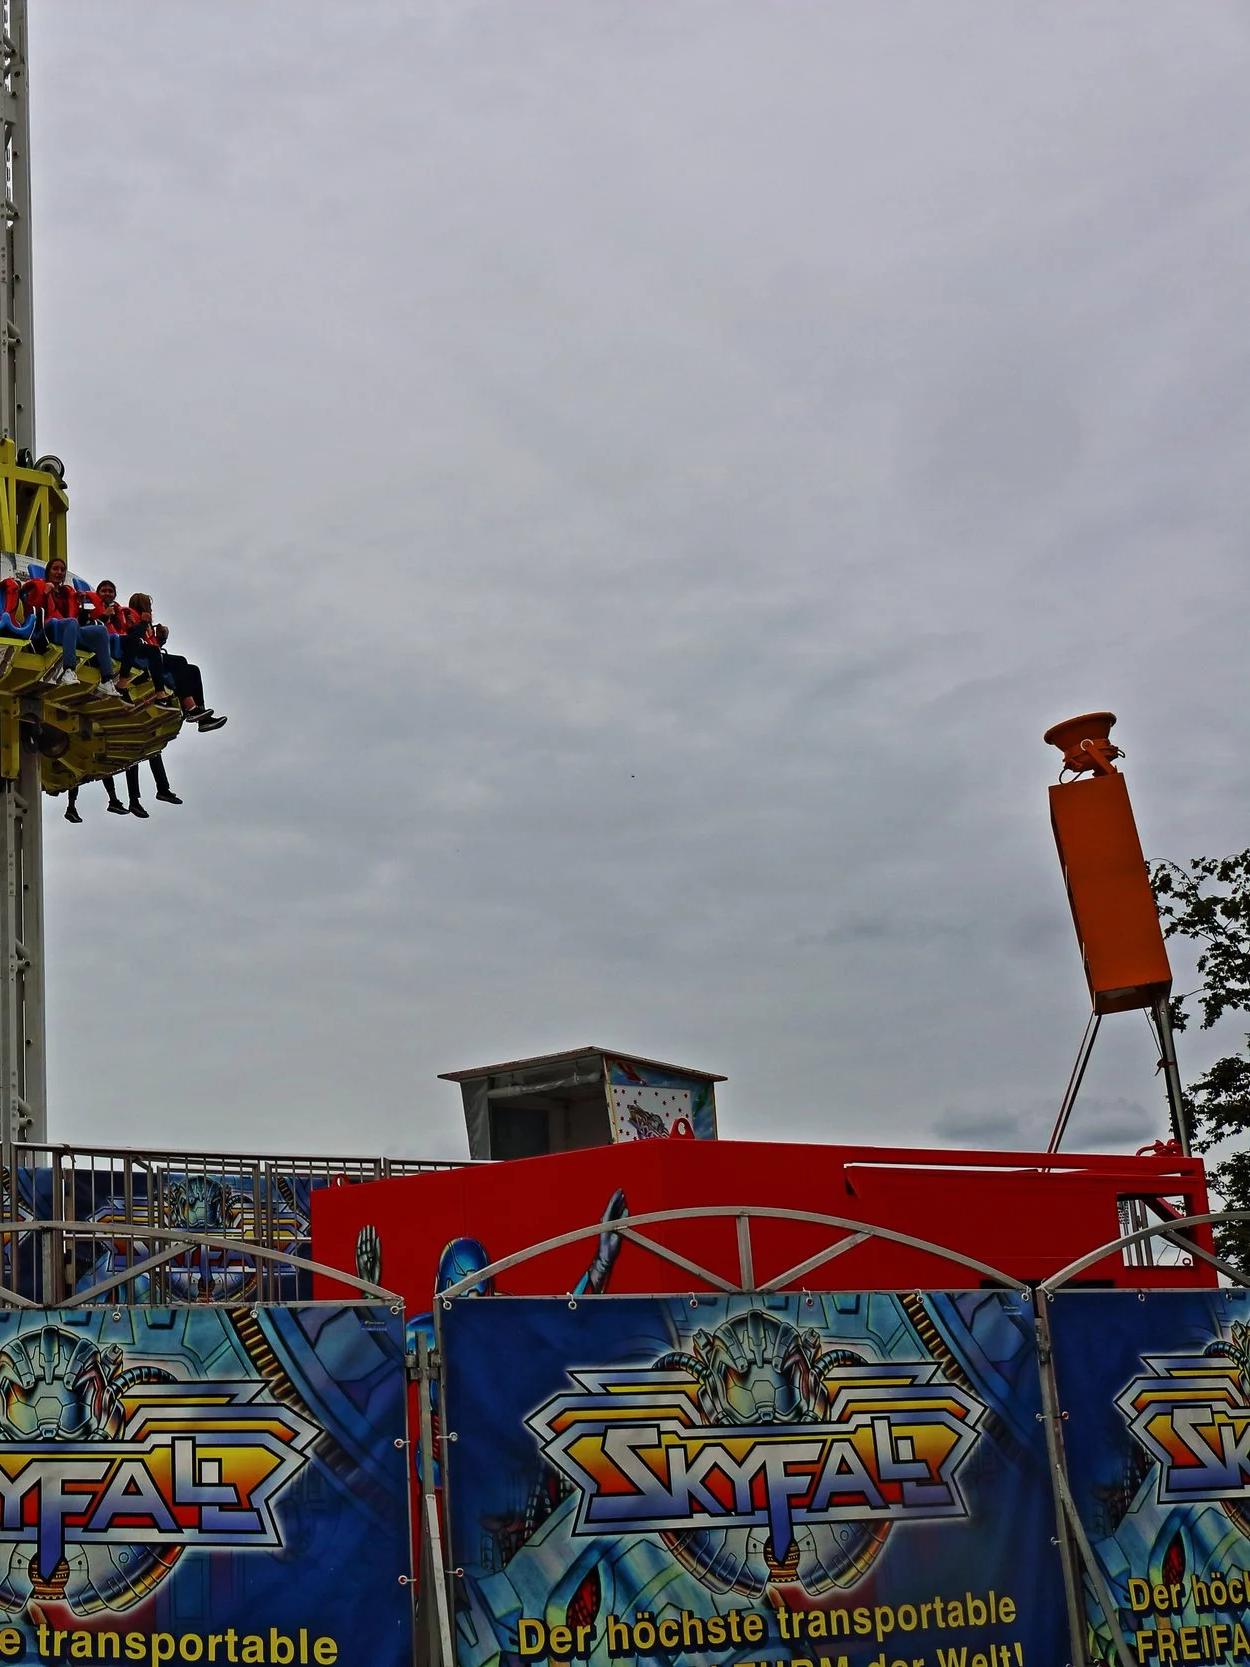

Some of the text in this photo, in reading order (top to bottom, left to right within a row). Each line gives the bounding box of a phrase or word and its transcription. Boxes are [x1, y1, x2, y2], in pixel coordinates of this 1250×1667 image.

[584, 1415, 956, 1565] SKYFALL
[1128, 1578, 1181, 1611] Der
[36, 1622, 338, 1667] transportable
[517, 1590, 1017, 1655] Der höchste transportable
